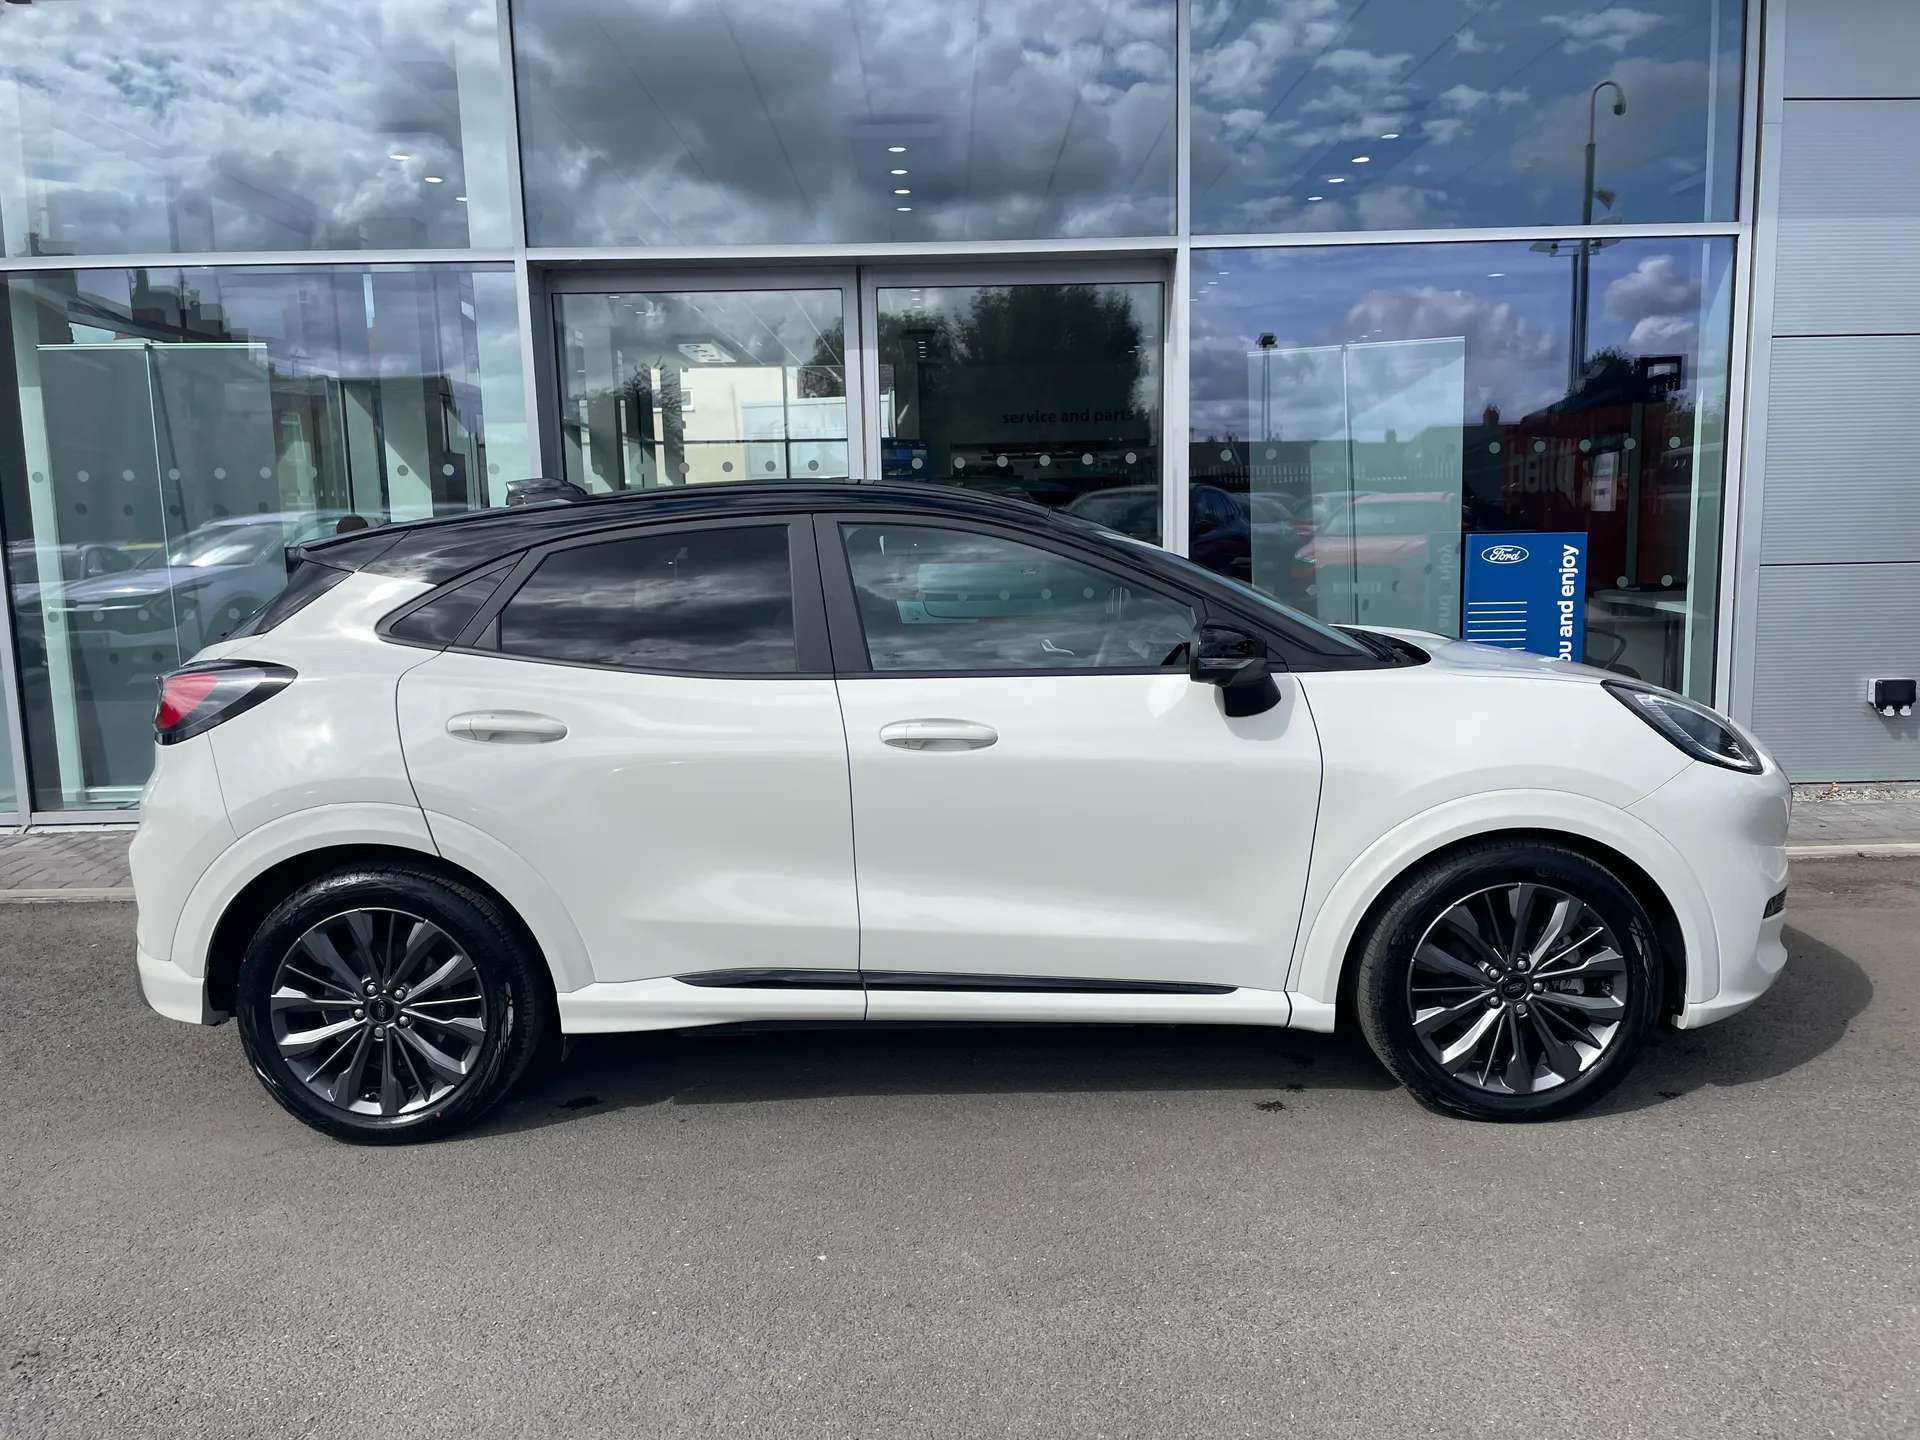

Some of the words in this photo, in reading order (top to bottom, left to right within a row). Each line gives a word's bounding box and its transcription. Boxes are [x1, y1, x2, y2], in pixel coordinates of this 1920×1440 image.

[1002, 410, 1056, 424] service
[1061, 408, 1089, 423] and
[1094, 408, 1135, 425] parts
[1489, 547, 1521, 561] Ford
[1559, 544, 1579, 597] enjoy
[1557, 600, 1574, 638] and
